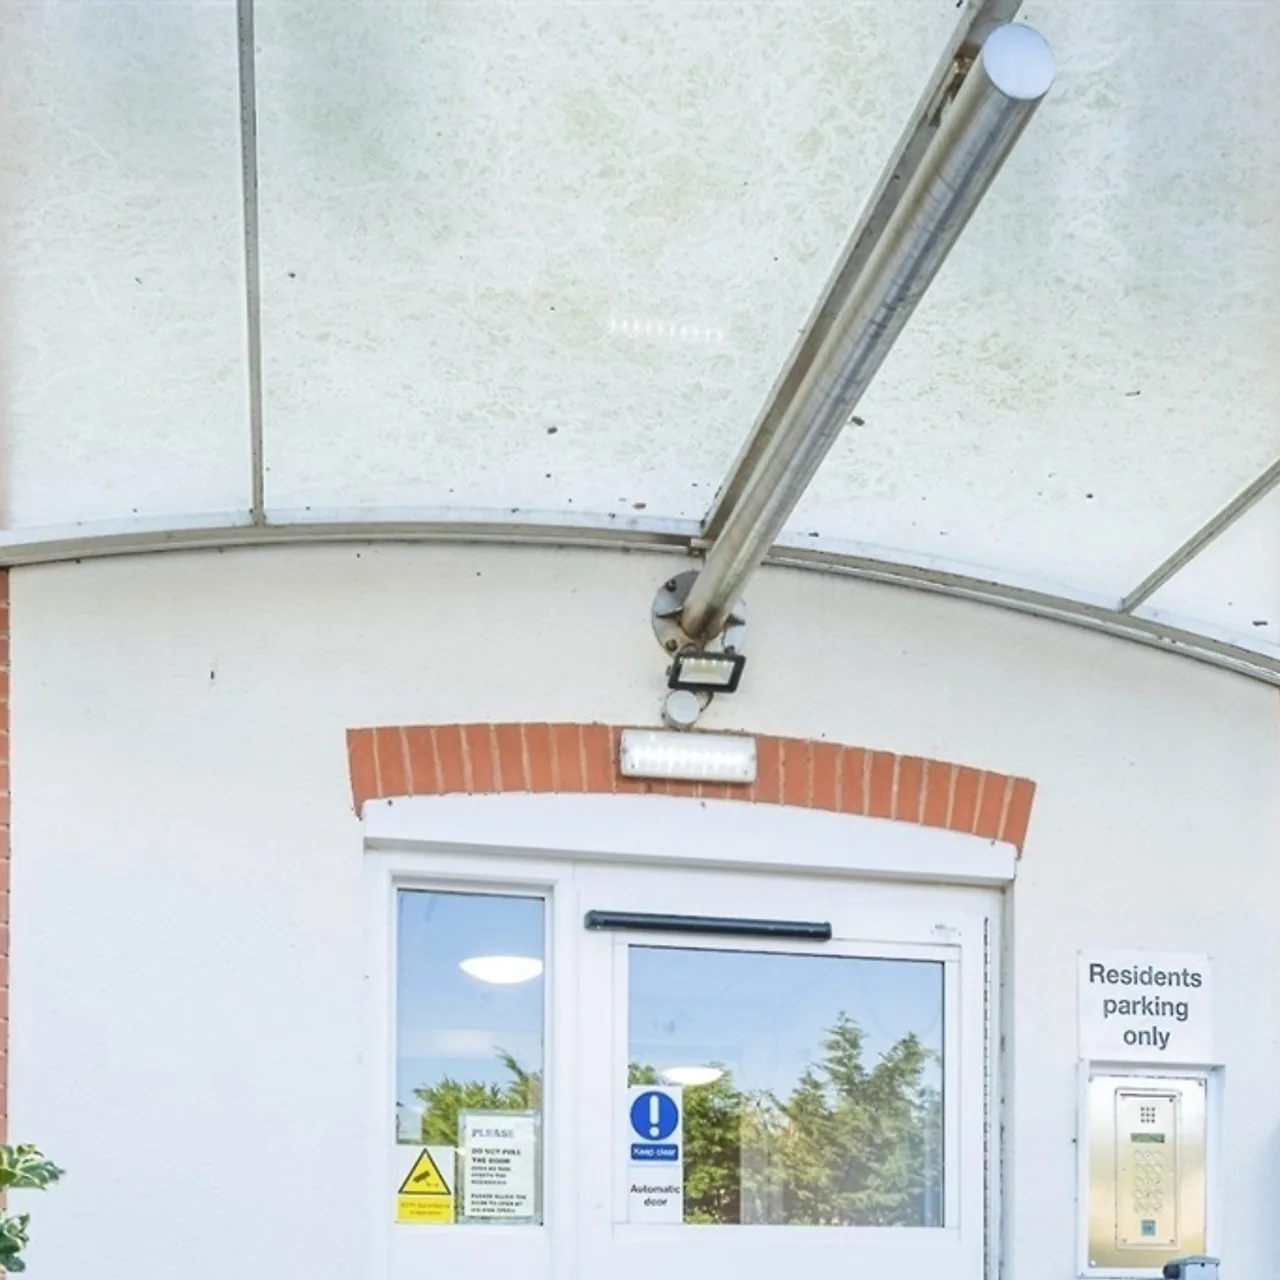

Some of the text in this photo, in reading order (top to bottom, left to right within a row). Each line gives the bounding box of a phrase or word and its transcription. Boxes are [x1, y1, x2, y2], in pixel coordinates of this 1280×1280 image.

[1089, 963, 1202, 988] Residents
[1103, 995, 1189, 1021] parking
[1123, 1025, 1170, 1050] only
[472, 1129, 514, 1138] PLEASE
[633, 1147, 677, 1157] Keep clear
[630, 1184, 680, 1193] Automatic
[644, 1197, 667, 1206] door
